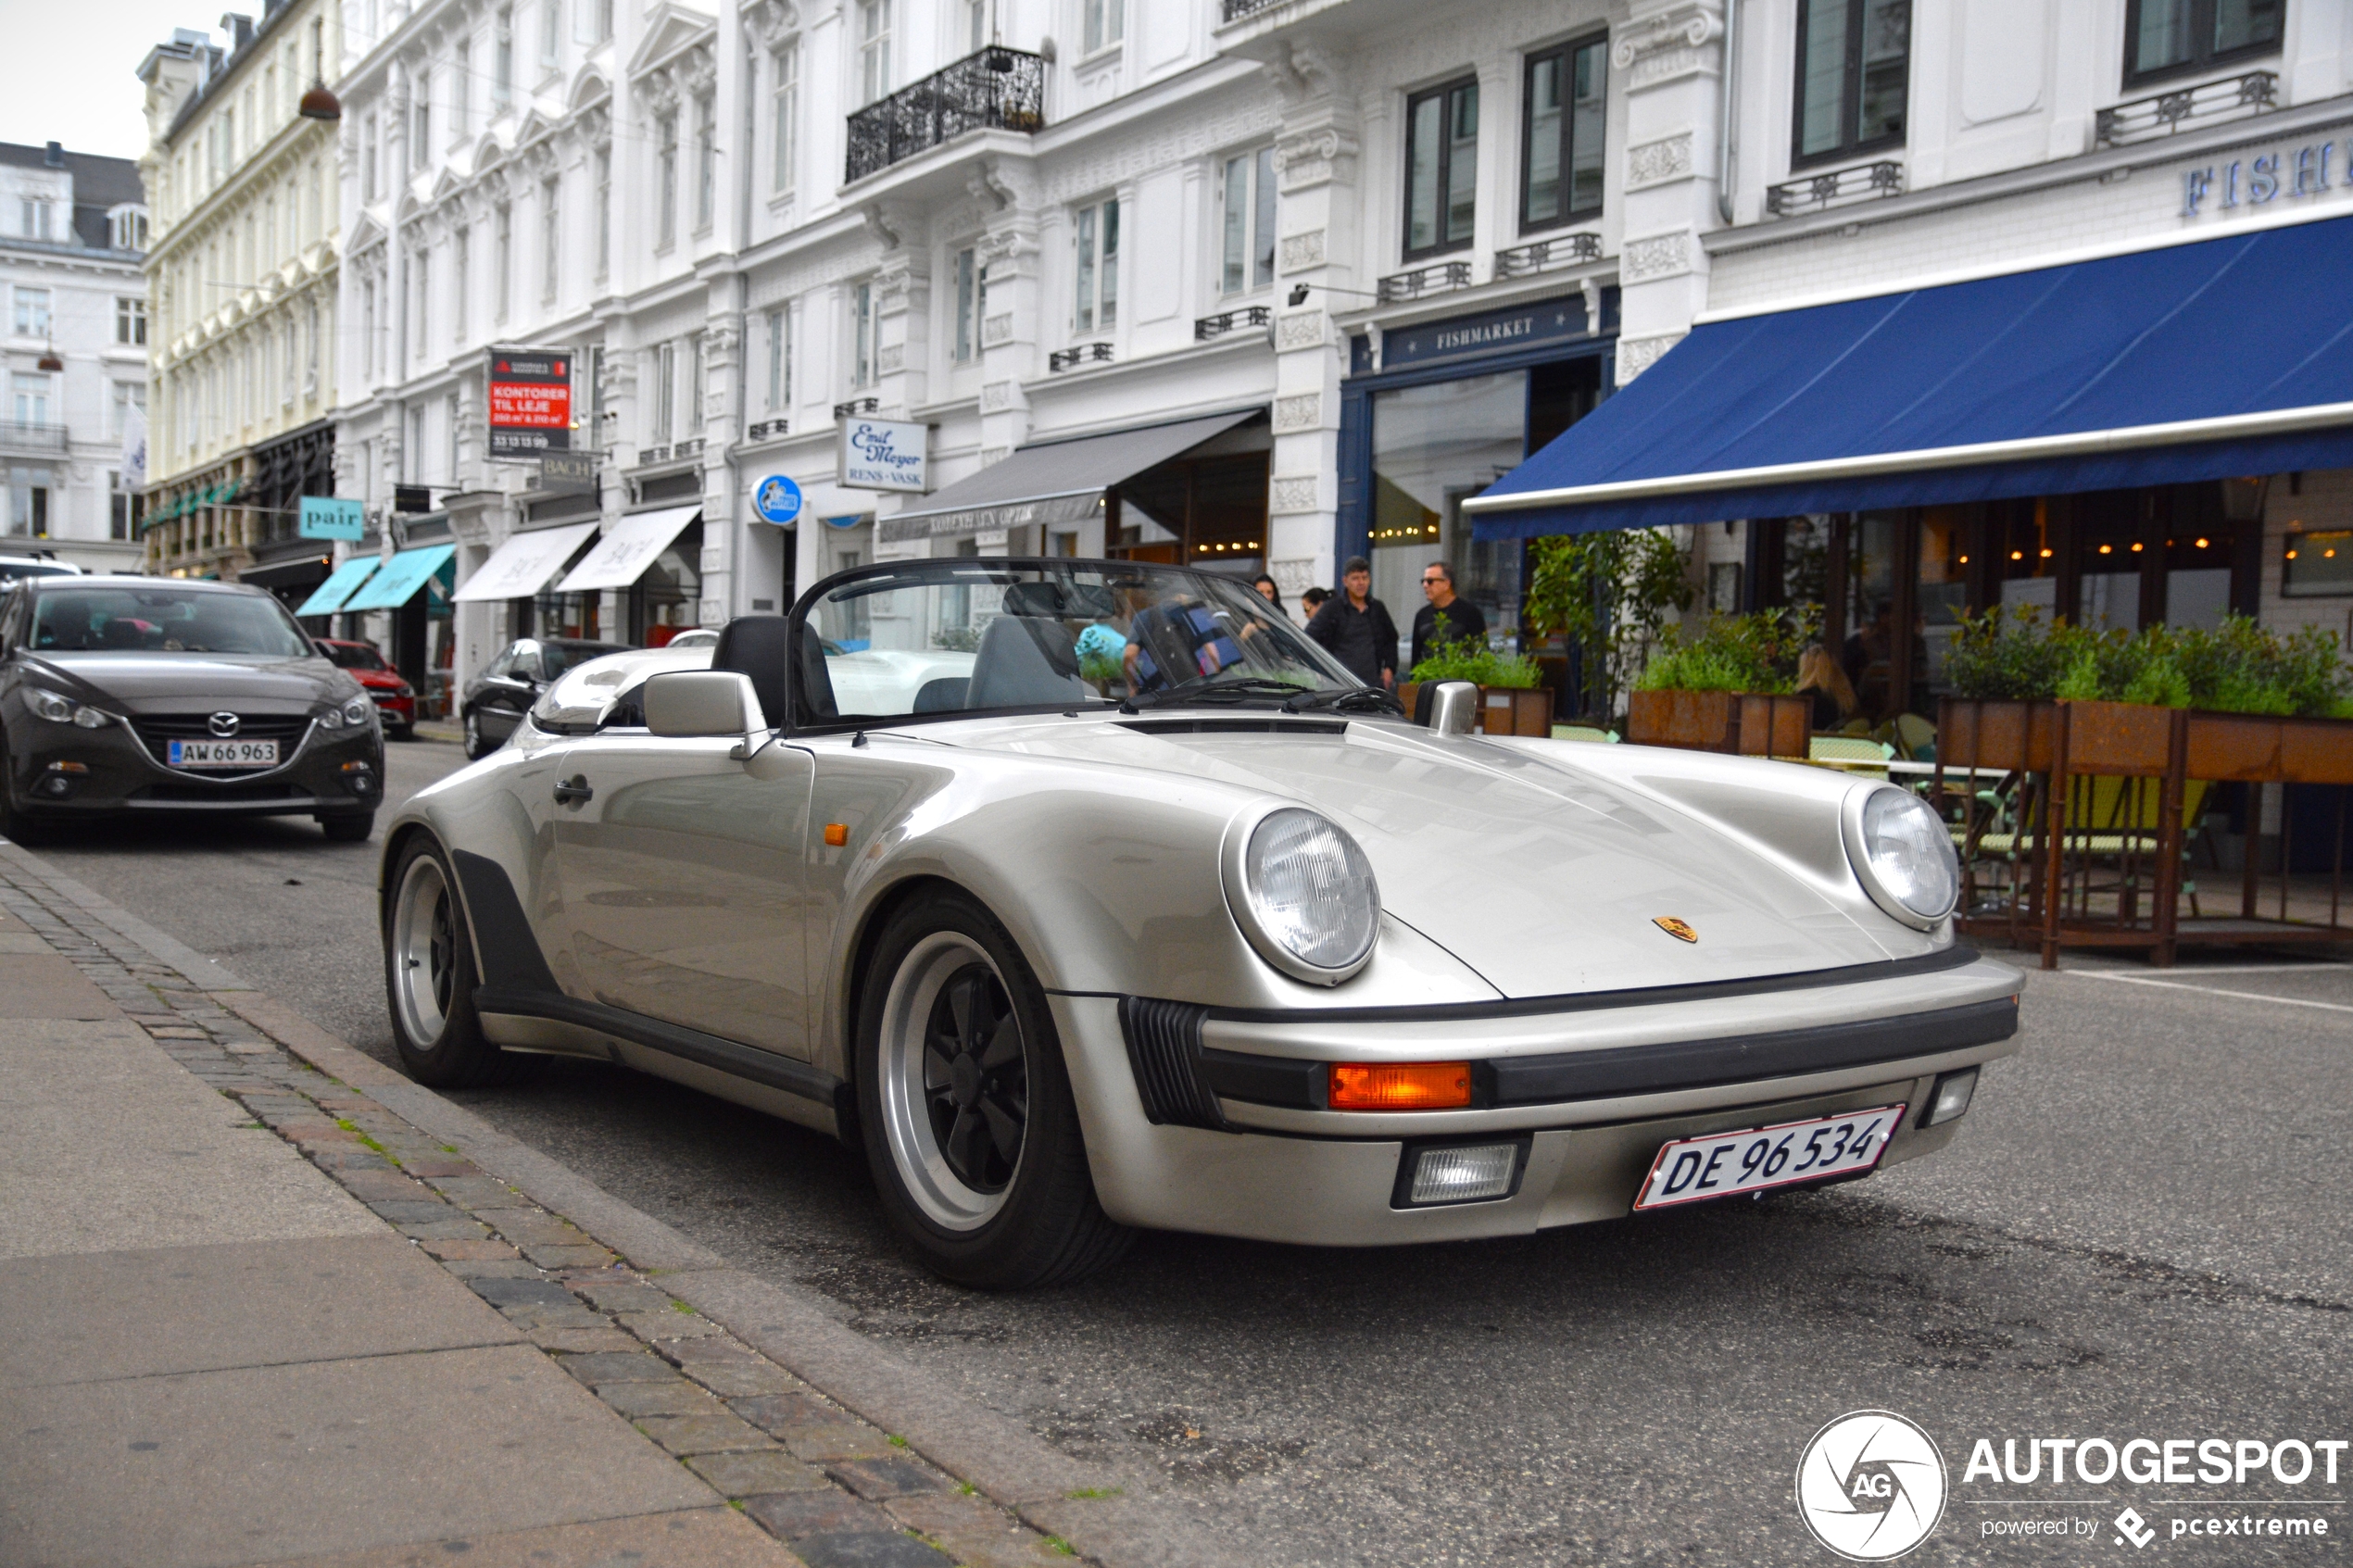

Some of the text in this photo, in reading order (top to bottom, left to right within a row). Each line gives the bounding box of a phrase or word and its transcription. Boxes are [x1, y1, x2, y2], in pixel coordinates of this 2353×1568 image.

[2179, 138, 2353, 217] FISH
[1437, 317, 1533, 350] FISHMARKET
[493, 386, 568, 400] KONTORER
[493, 399, 550, 413] TIL LEJE
[851, 423, 893, 449] Emil
[544, 458, 589, 477] BACH
[866, 445, 921, 469] Meyer
[307, 507, 359, 531] pair
[183, 745, 208, 760] AW
[214, 745, 236, 760] 66
[242, 745, 274, 760] 963
[1661, 1118, 1882, 1197] DE 96 534
